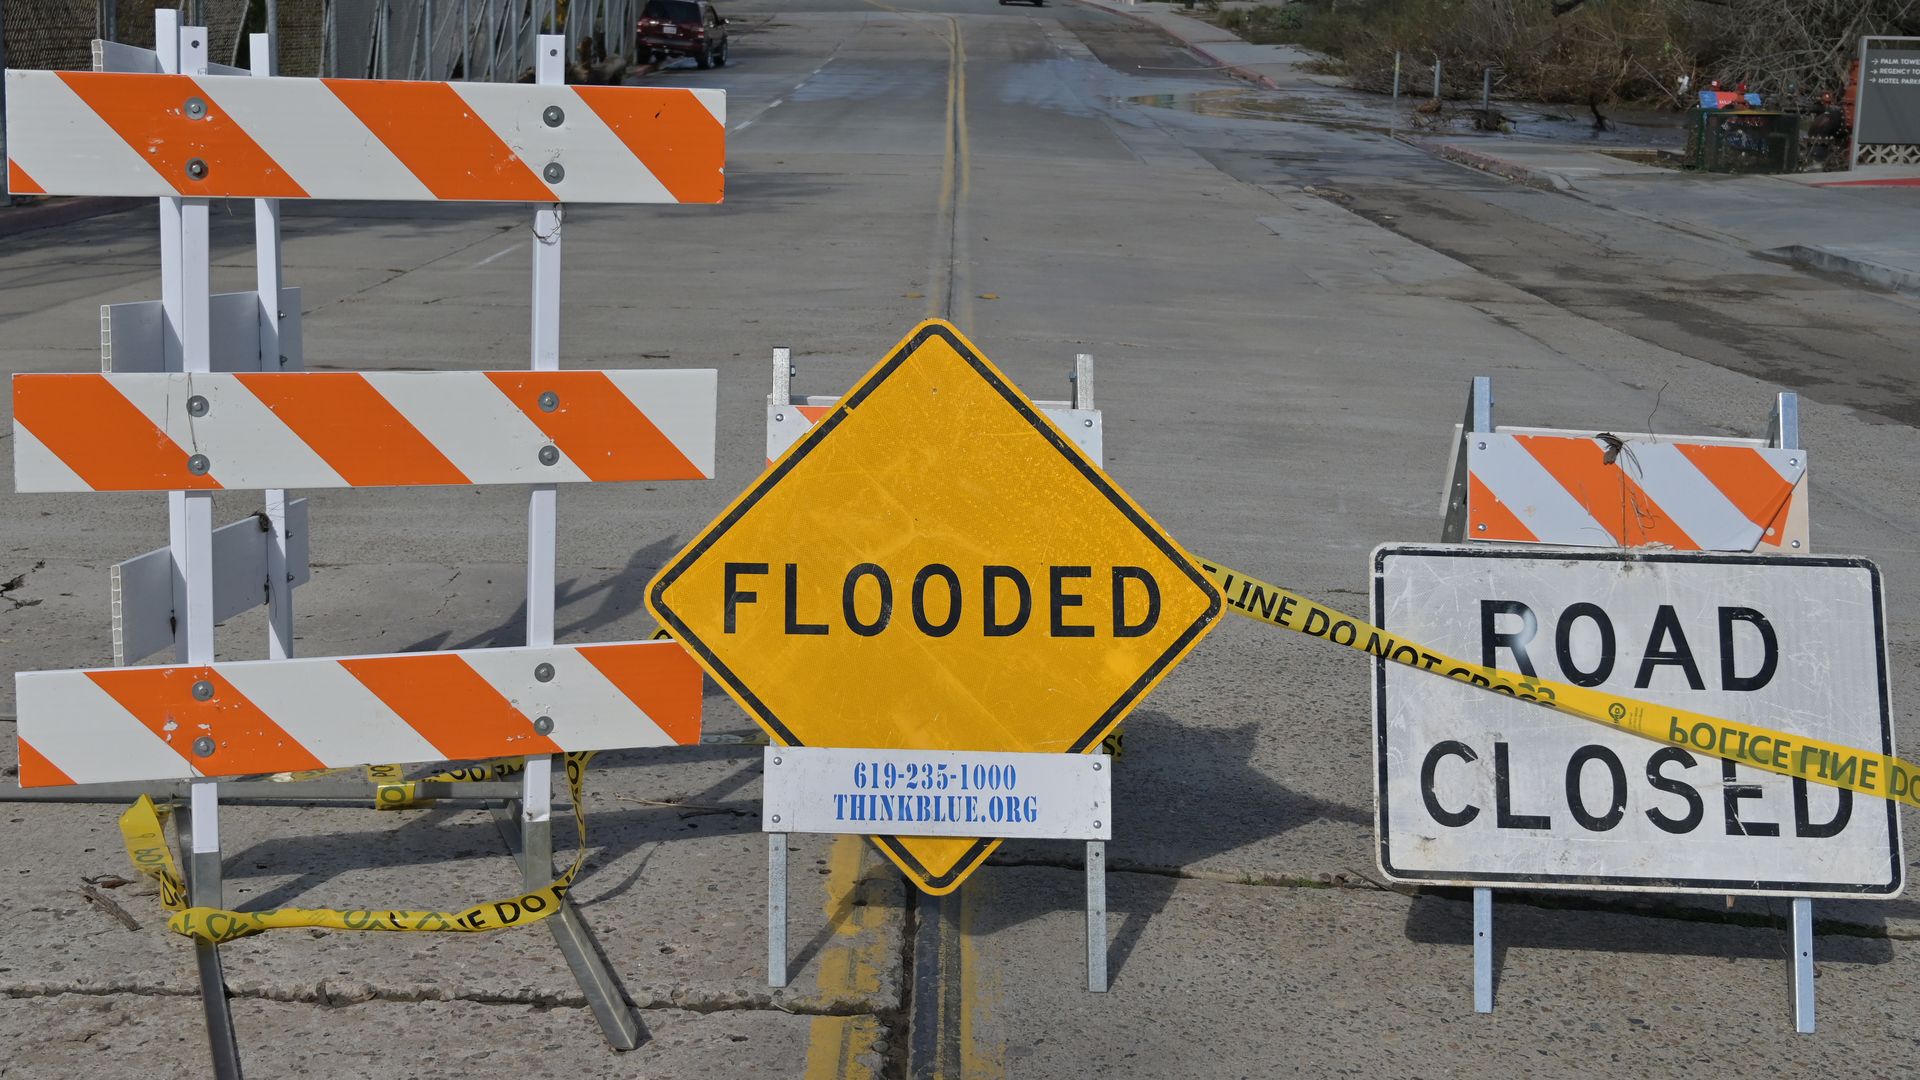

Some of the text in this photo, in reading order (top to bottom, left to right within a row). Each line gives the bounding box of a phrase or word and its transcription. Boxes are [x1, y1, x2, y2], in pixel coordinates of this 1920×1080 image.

[1879, 67, 1911, 75] REGENCY
[723, 561, 1162, 639] FLOODED
[1223, 574, 1297, 627] LINE
[1302, 608, 1357, 646] DO
[1480, 599, 1779, 692] ROAD
[854, 762, 1016, 790] 619-235-1000
[1420, 740, 1853, 838] CLOSED
[834, 794, 1037, 823] THINKBLUE.ORG
[493, 895, 546, 925] DO
